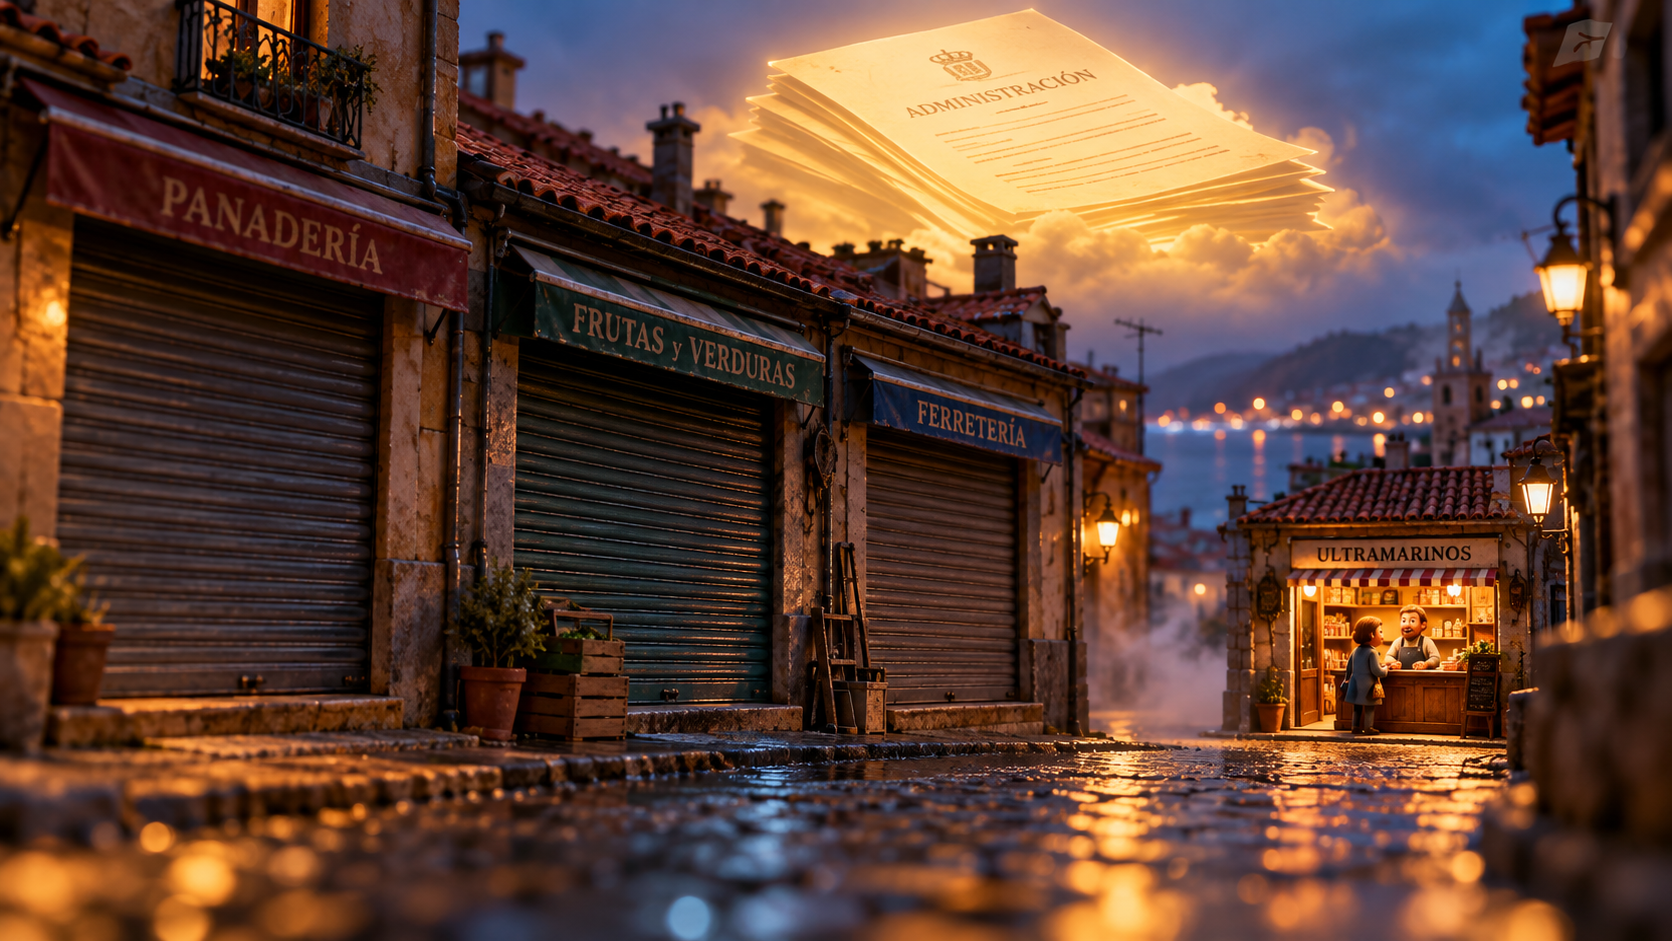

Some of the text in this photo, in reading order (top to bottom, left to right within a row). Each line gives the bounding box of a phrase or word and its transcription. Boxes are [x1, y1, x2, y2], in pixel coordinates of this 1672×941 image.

[906, 69, 1098, 118] ADMINISTRACIÓN
[160, 175, 383, 275] PANADERÍA
[572, 302, 796, 389] FRUTAS y VERDURAS
[917, 399, 1027, 449] FERRETERÍA
[1317, 545, 1472, 562] ULTRAMARINOS
